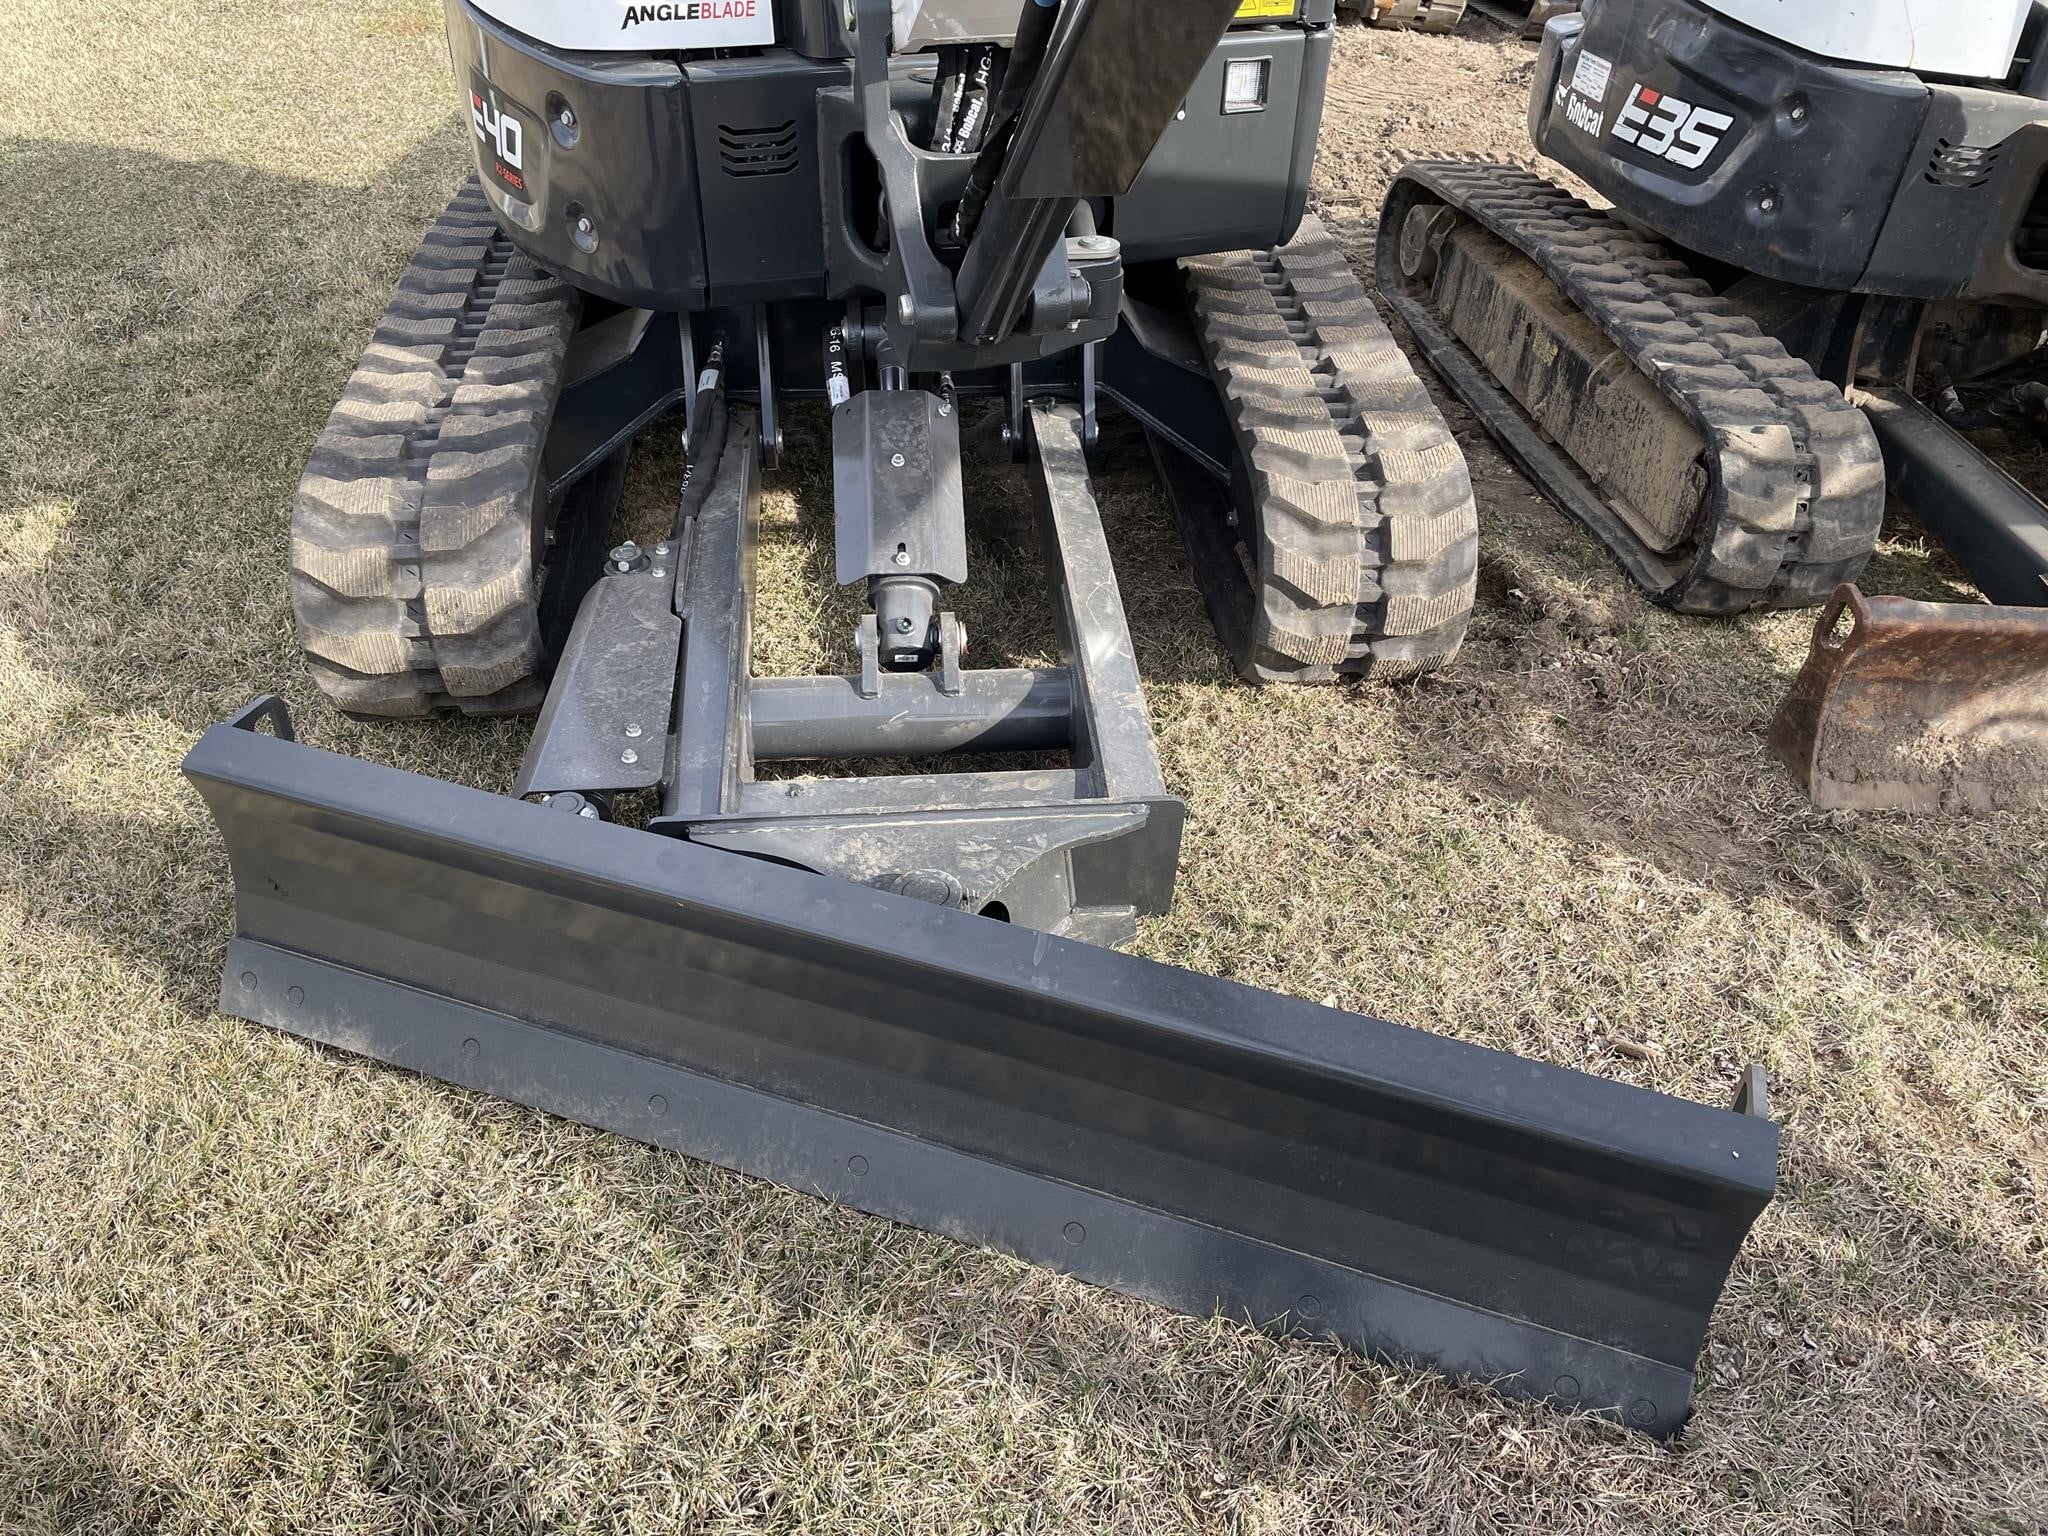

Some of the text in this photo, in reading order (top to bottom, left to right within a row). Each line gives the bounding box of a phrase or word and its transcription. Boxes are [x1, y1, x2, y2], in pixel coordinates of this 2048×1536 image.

[621, 1, 756, 30] ANGLEBLADE
[468, 87, 523, 170] E40
[958, 97, 985, 139] Bobcat
[1565, 92, 1605, 138] Bobcat
[1610, 82, 1735, 169] E35
